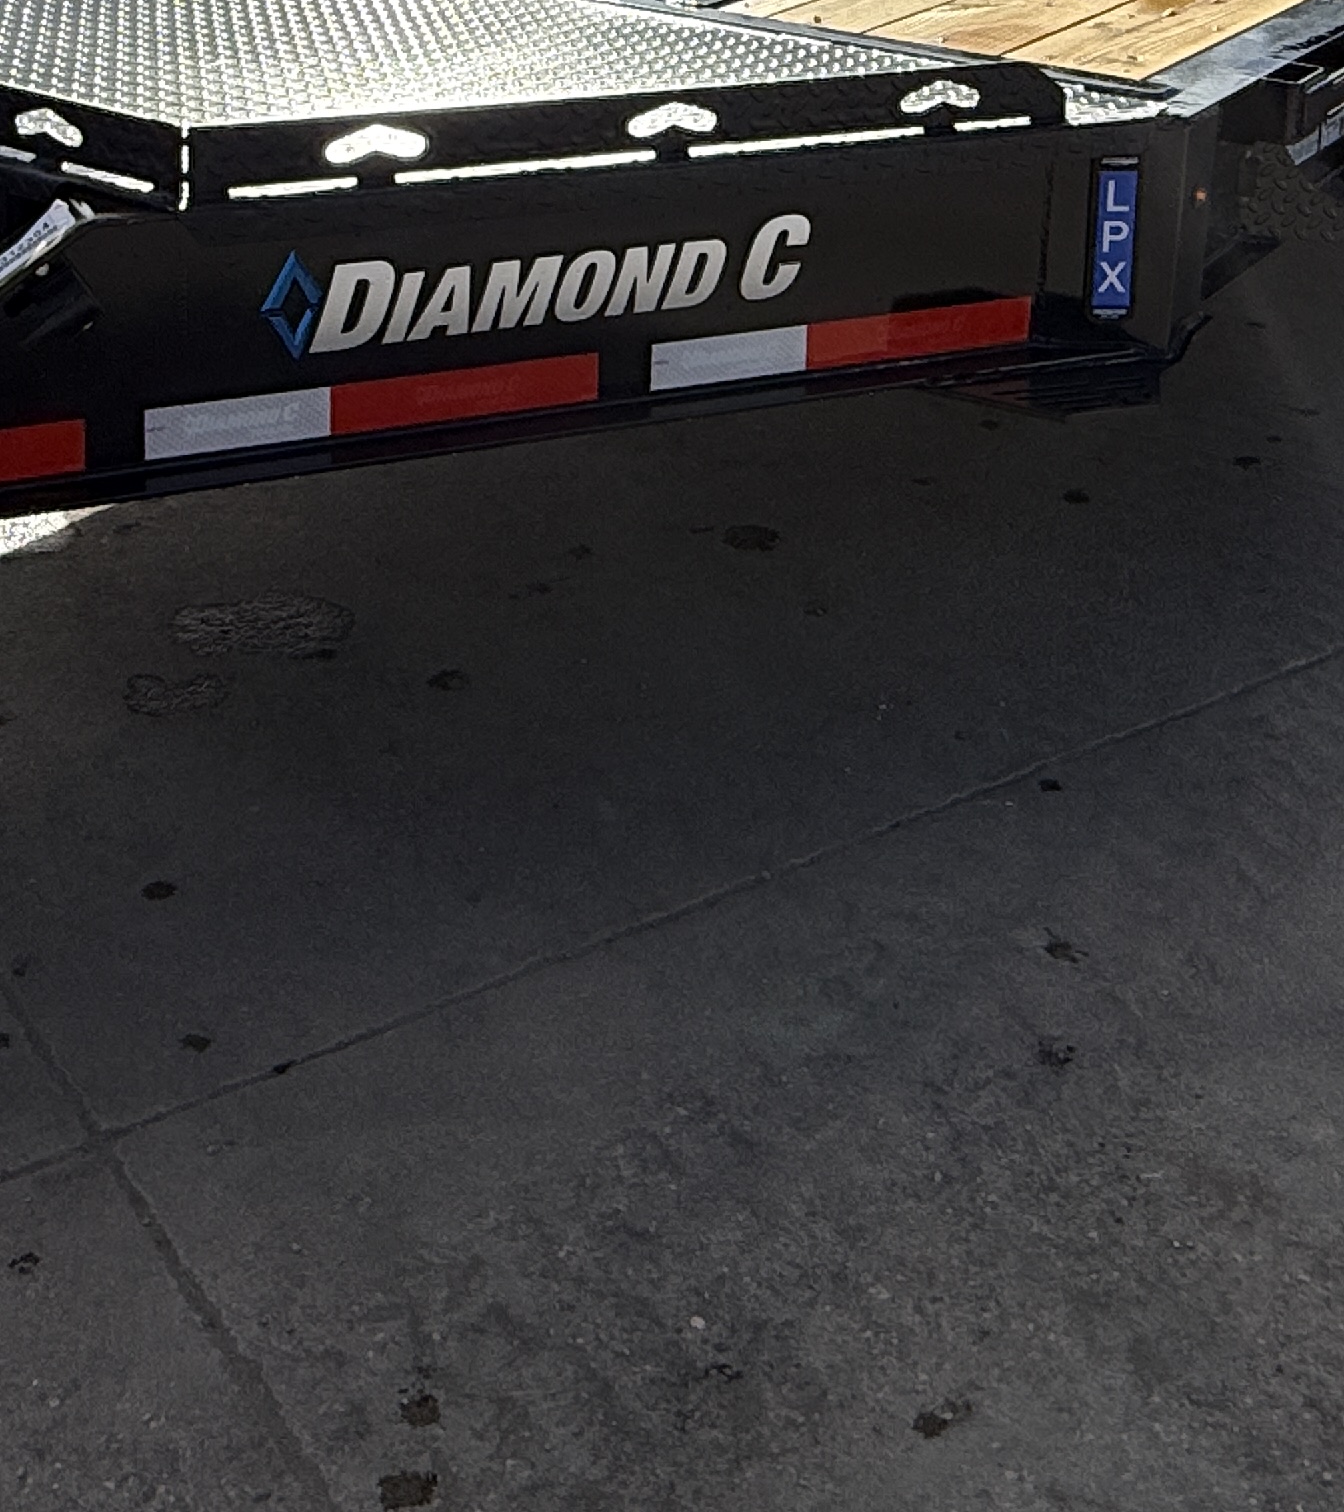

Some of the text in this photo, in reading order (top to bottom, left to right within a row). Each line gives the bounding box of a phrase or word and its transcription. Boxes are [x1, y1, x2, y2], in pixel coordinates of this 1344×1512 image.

[308, 213, 812, 354] DIAMOND C
[1098, 180, 1130, 294] LPX
